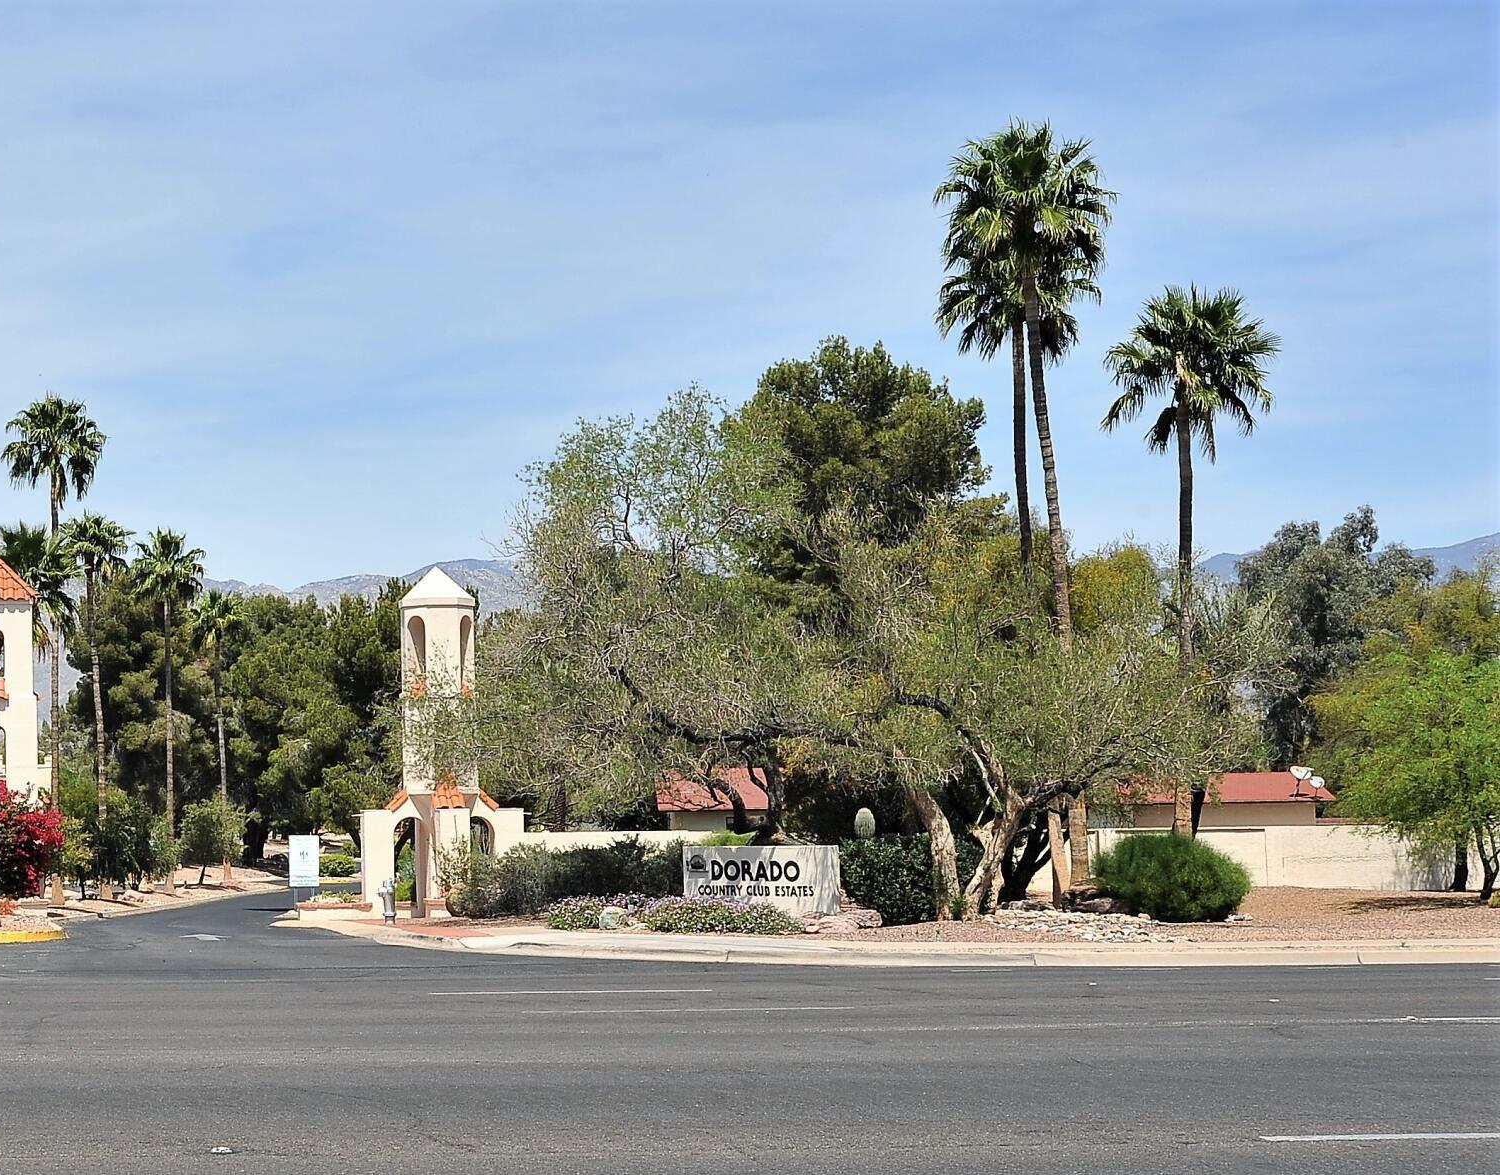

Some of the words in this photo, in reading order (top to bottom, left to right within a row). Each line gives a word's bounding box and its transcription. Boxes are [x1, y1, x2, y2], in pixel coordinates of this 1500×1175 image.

[710, 859, 800, 882] DORADO
[698, 884, 742, 896] COUNTRY
[746, 885, 770, 897] CLUB
[775, 885, 815, 897] ESTATES
